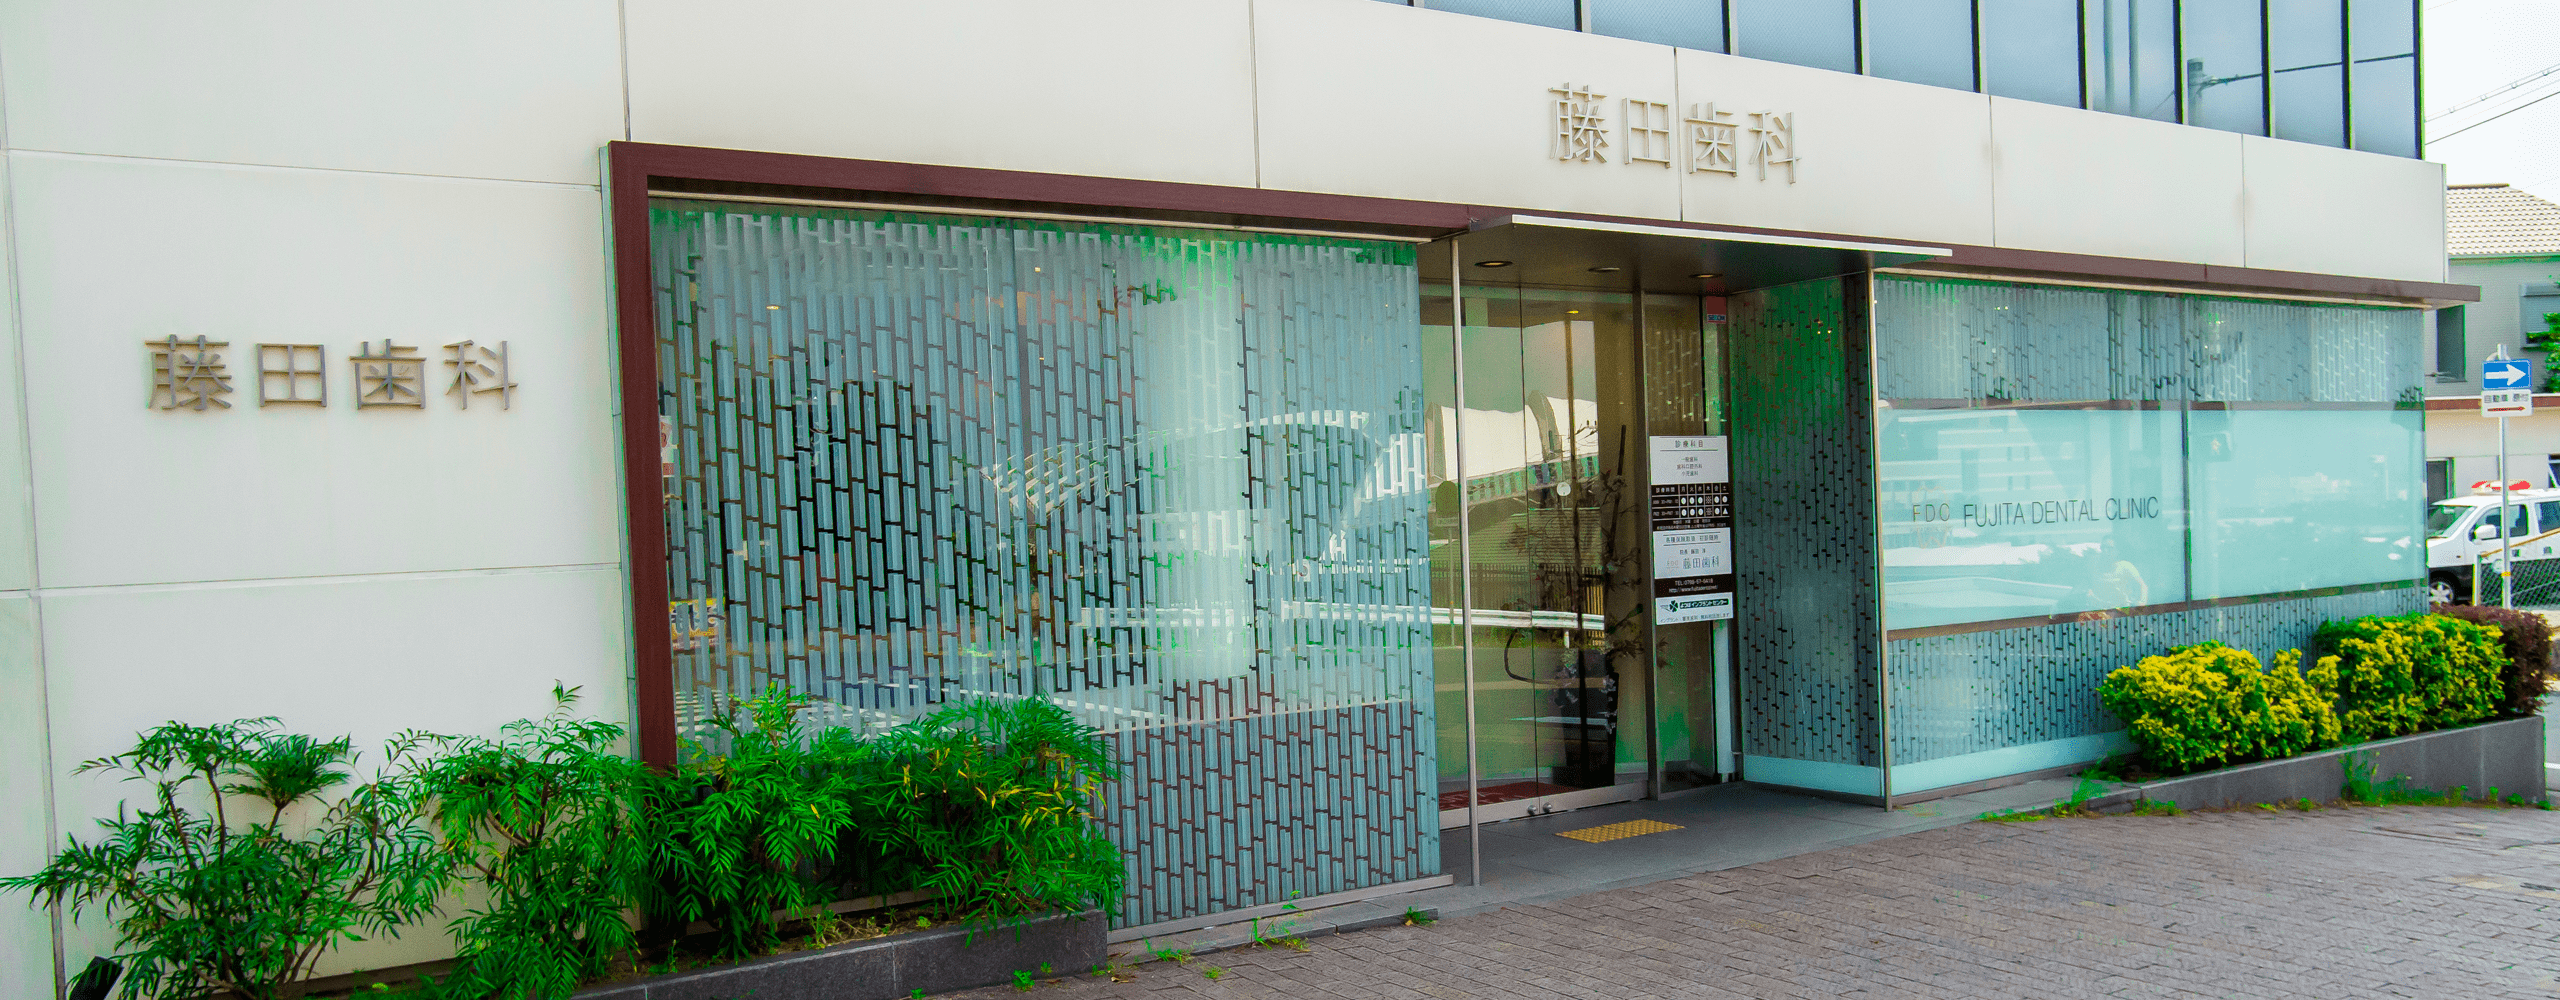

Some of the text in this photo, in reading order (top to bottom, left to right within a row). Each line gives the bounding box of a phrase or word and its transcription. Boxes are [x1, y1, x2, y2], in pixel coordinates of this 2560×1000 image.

[1547, 81, 1802, 184] 藤田歯科
[144, 333, 519, 411] 藤田歯科
[1675, 440, 1703, 448] 診療科目
[1963, 502, 2026, 527] FUJITA
[2031, 499, 2100, 524] DENTAL
[2105, 496, 2159, 521] CLINIC
[1683, 556, 1719, 569] 藤田歯科
